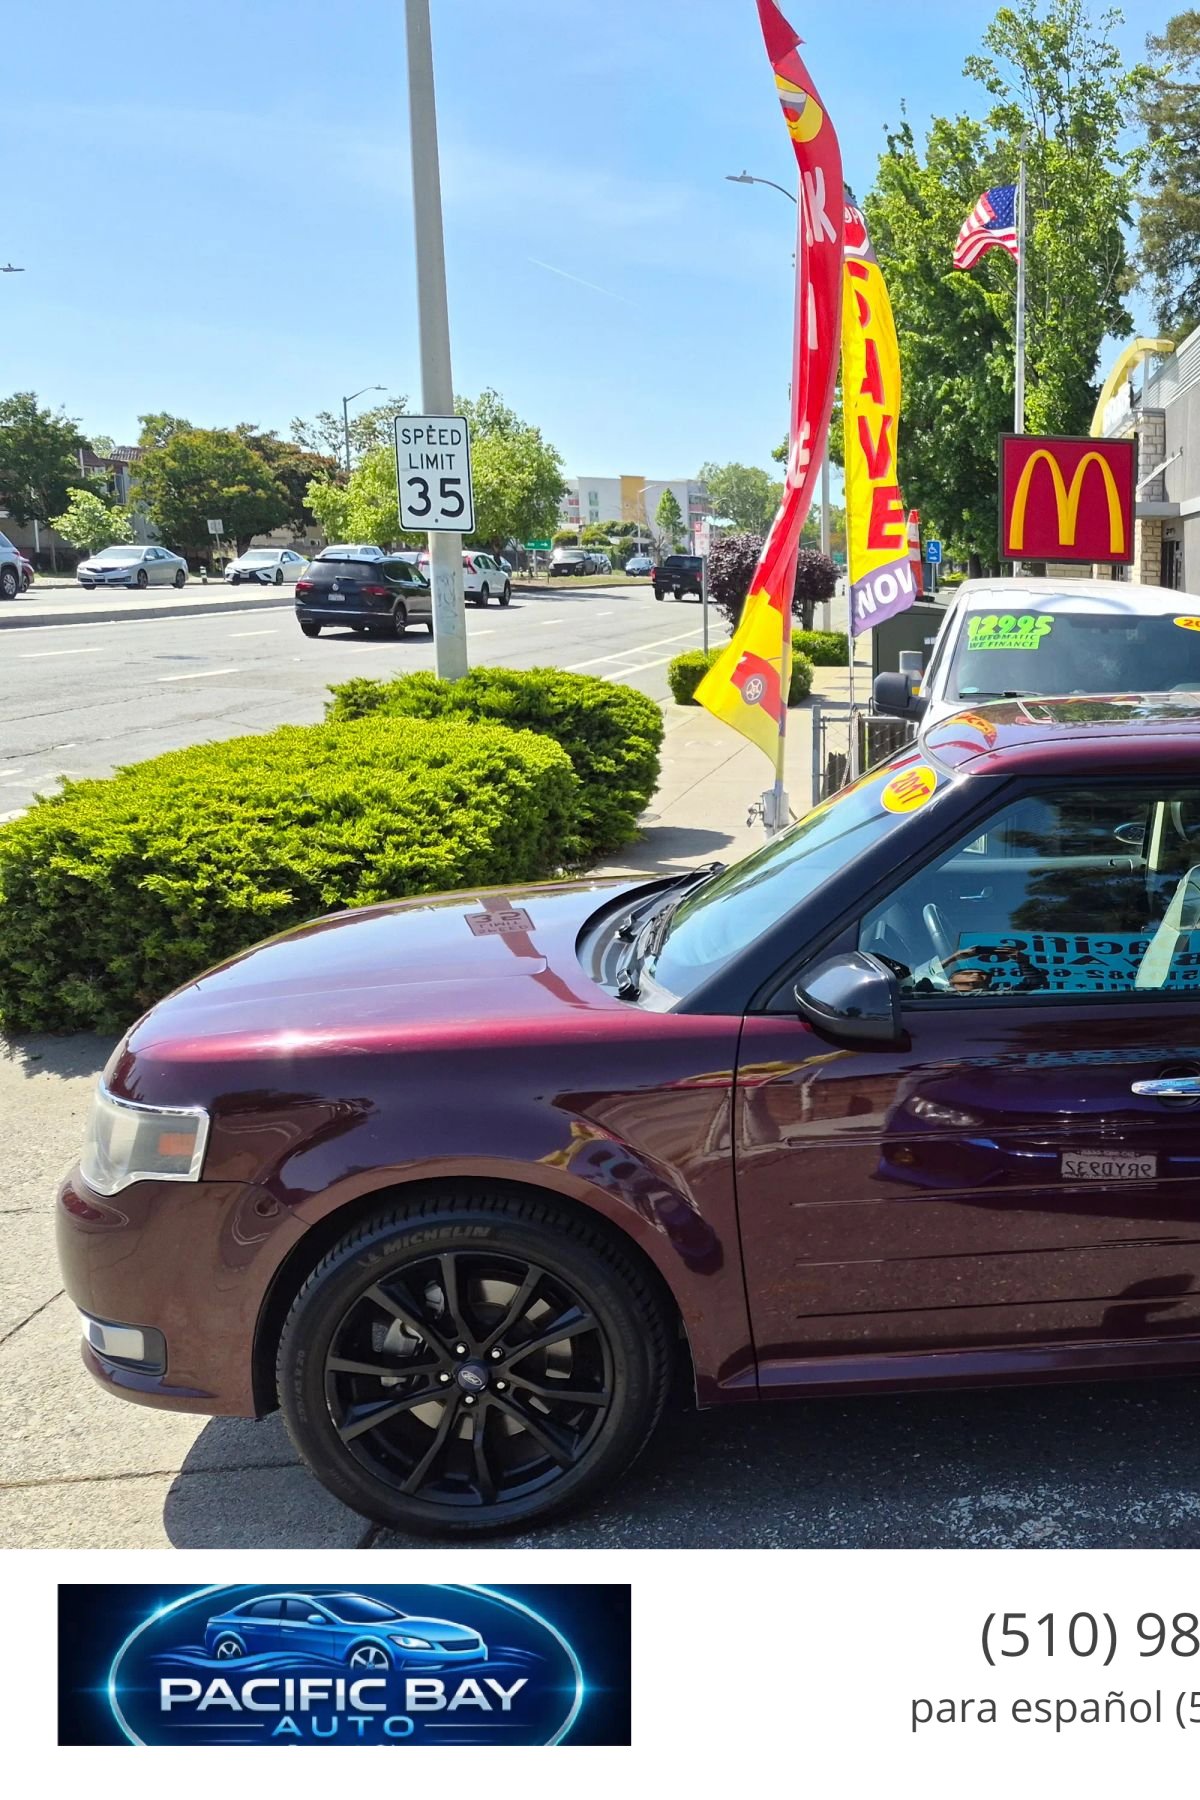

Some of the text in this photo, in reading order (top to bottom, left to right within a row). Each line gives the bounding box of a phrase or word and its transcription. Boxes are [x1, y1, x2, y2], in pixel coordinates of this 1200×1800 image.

[401, 428, 462, 446] SPEED
[408, 452, 456, 471] LIMIT
[407, 476, 465, 518] 35
[968, 614, 1055, 638] 12995
[890, 772, 930, 804] 2017
[382, 1225, 491, 1256] MICHELIN
